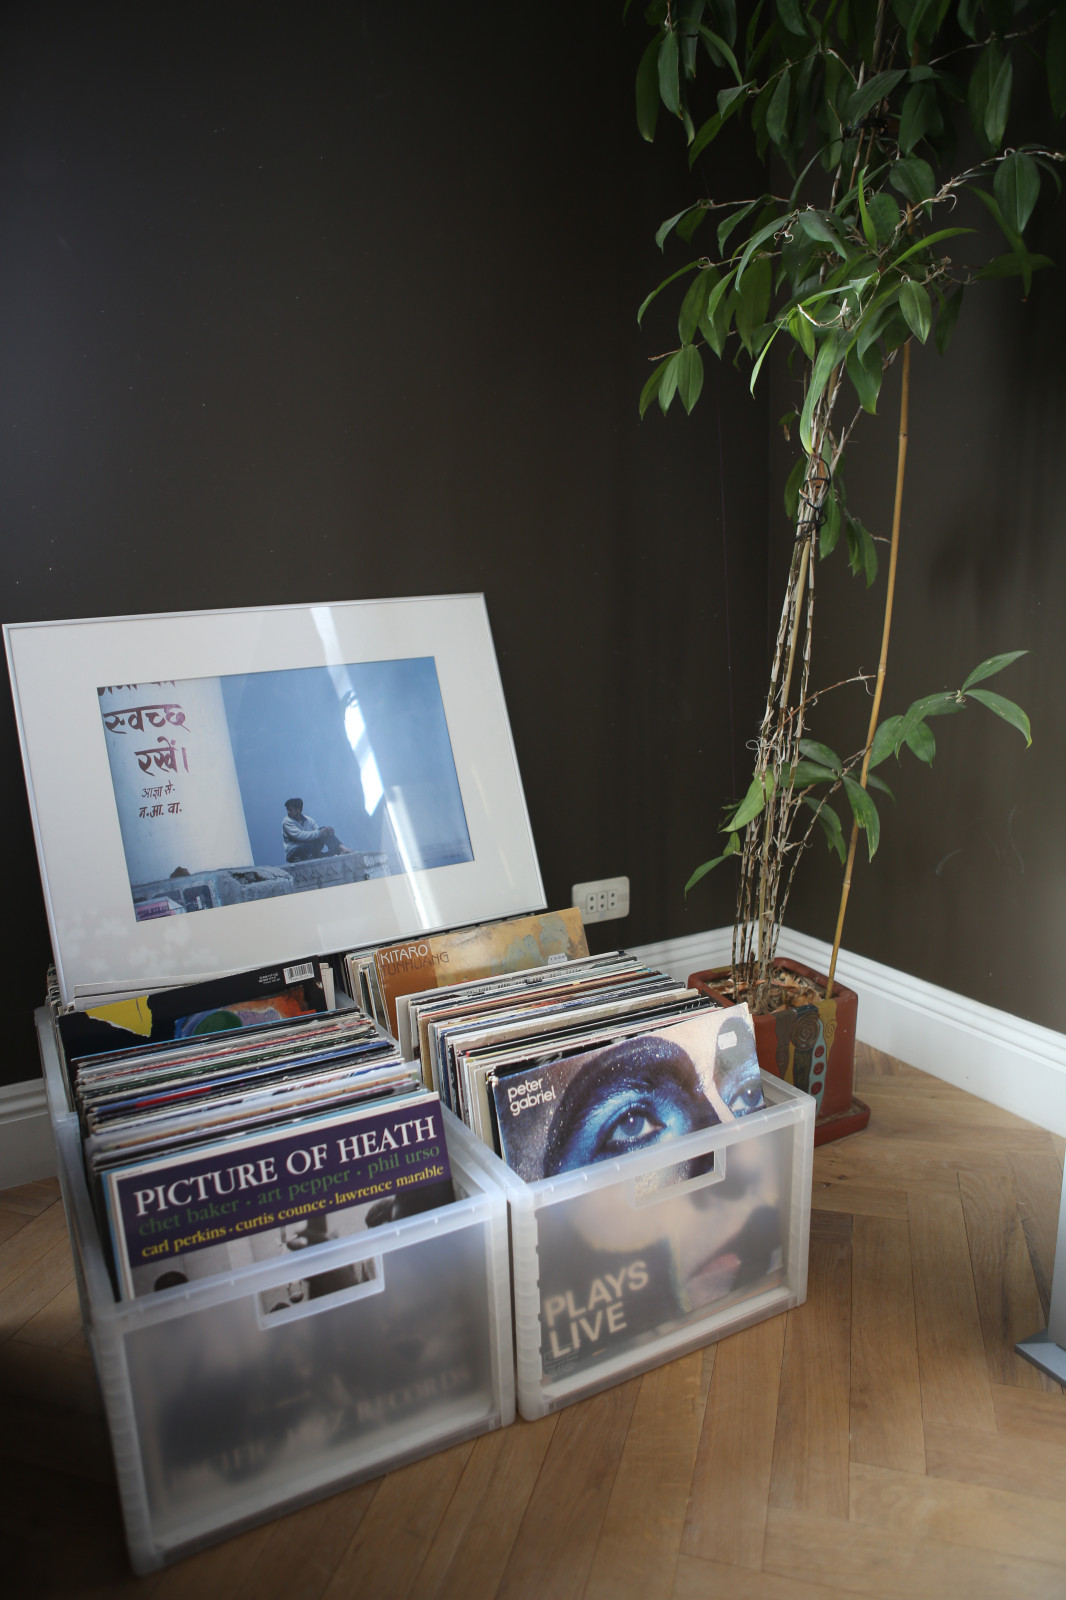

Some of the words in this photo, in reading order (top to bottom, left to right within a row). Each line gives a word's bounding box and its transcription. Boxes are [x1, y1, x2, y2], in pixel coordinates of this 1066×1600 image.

[380, 944, 428, 965] KITARO
[507, 1077, 544, 1102] peter
[510, 1086, 557, 1117] gabriel
[133, 1157, 278, 1217] PICTURE
[286, 1144, 328, 1176] OF
[336, 1115, 437, 1164] HEATH
[138, 1212, 181, 1236] chet
[186, 1197, 240, 1225] baker
[257, 1185, 283, 1205] art
[289, 1169, 350, 1201] pepper
[367, 1153, 400, 1179] phil
[405, 1145, 441, 1163] urso
[141, 1237, 170, 1258] carl
[173, 1224, 227, 1251] perkins
[235, 1210, 275, 1233] curtis
[277, 1198, 327, 1220] counce
[335, 1177, 393, 1204] lawrence
[396, 1163, 444, 1187] marable
[545, 1260, 649, 1326] PLAYS
[550, 1302, 628, 1358] LIVE
